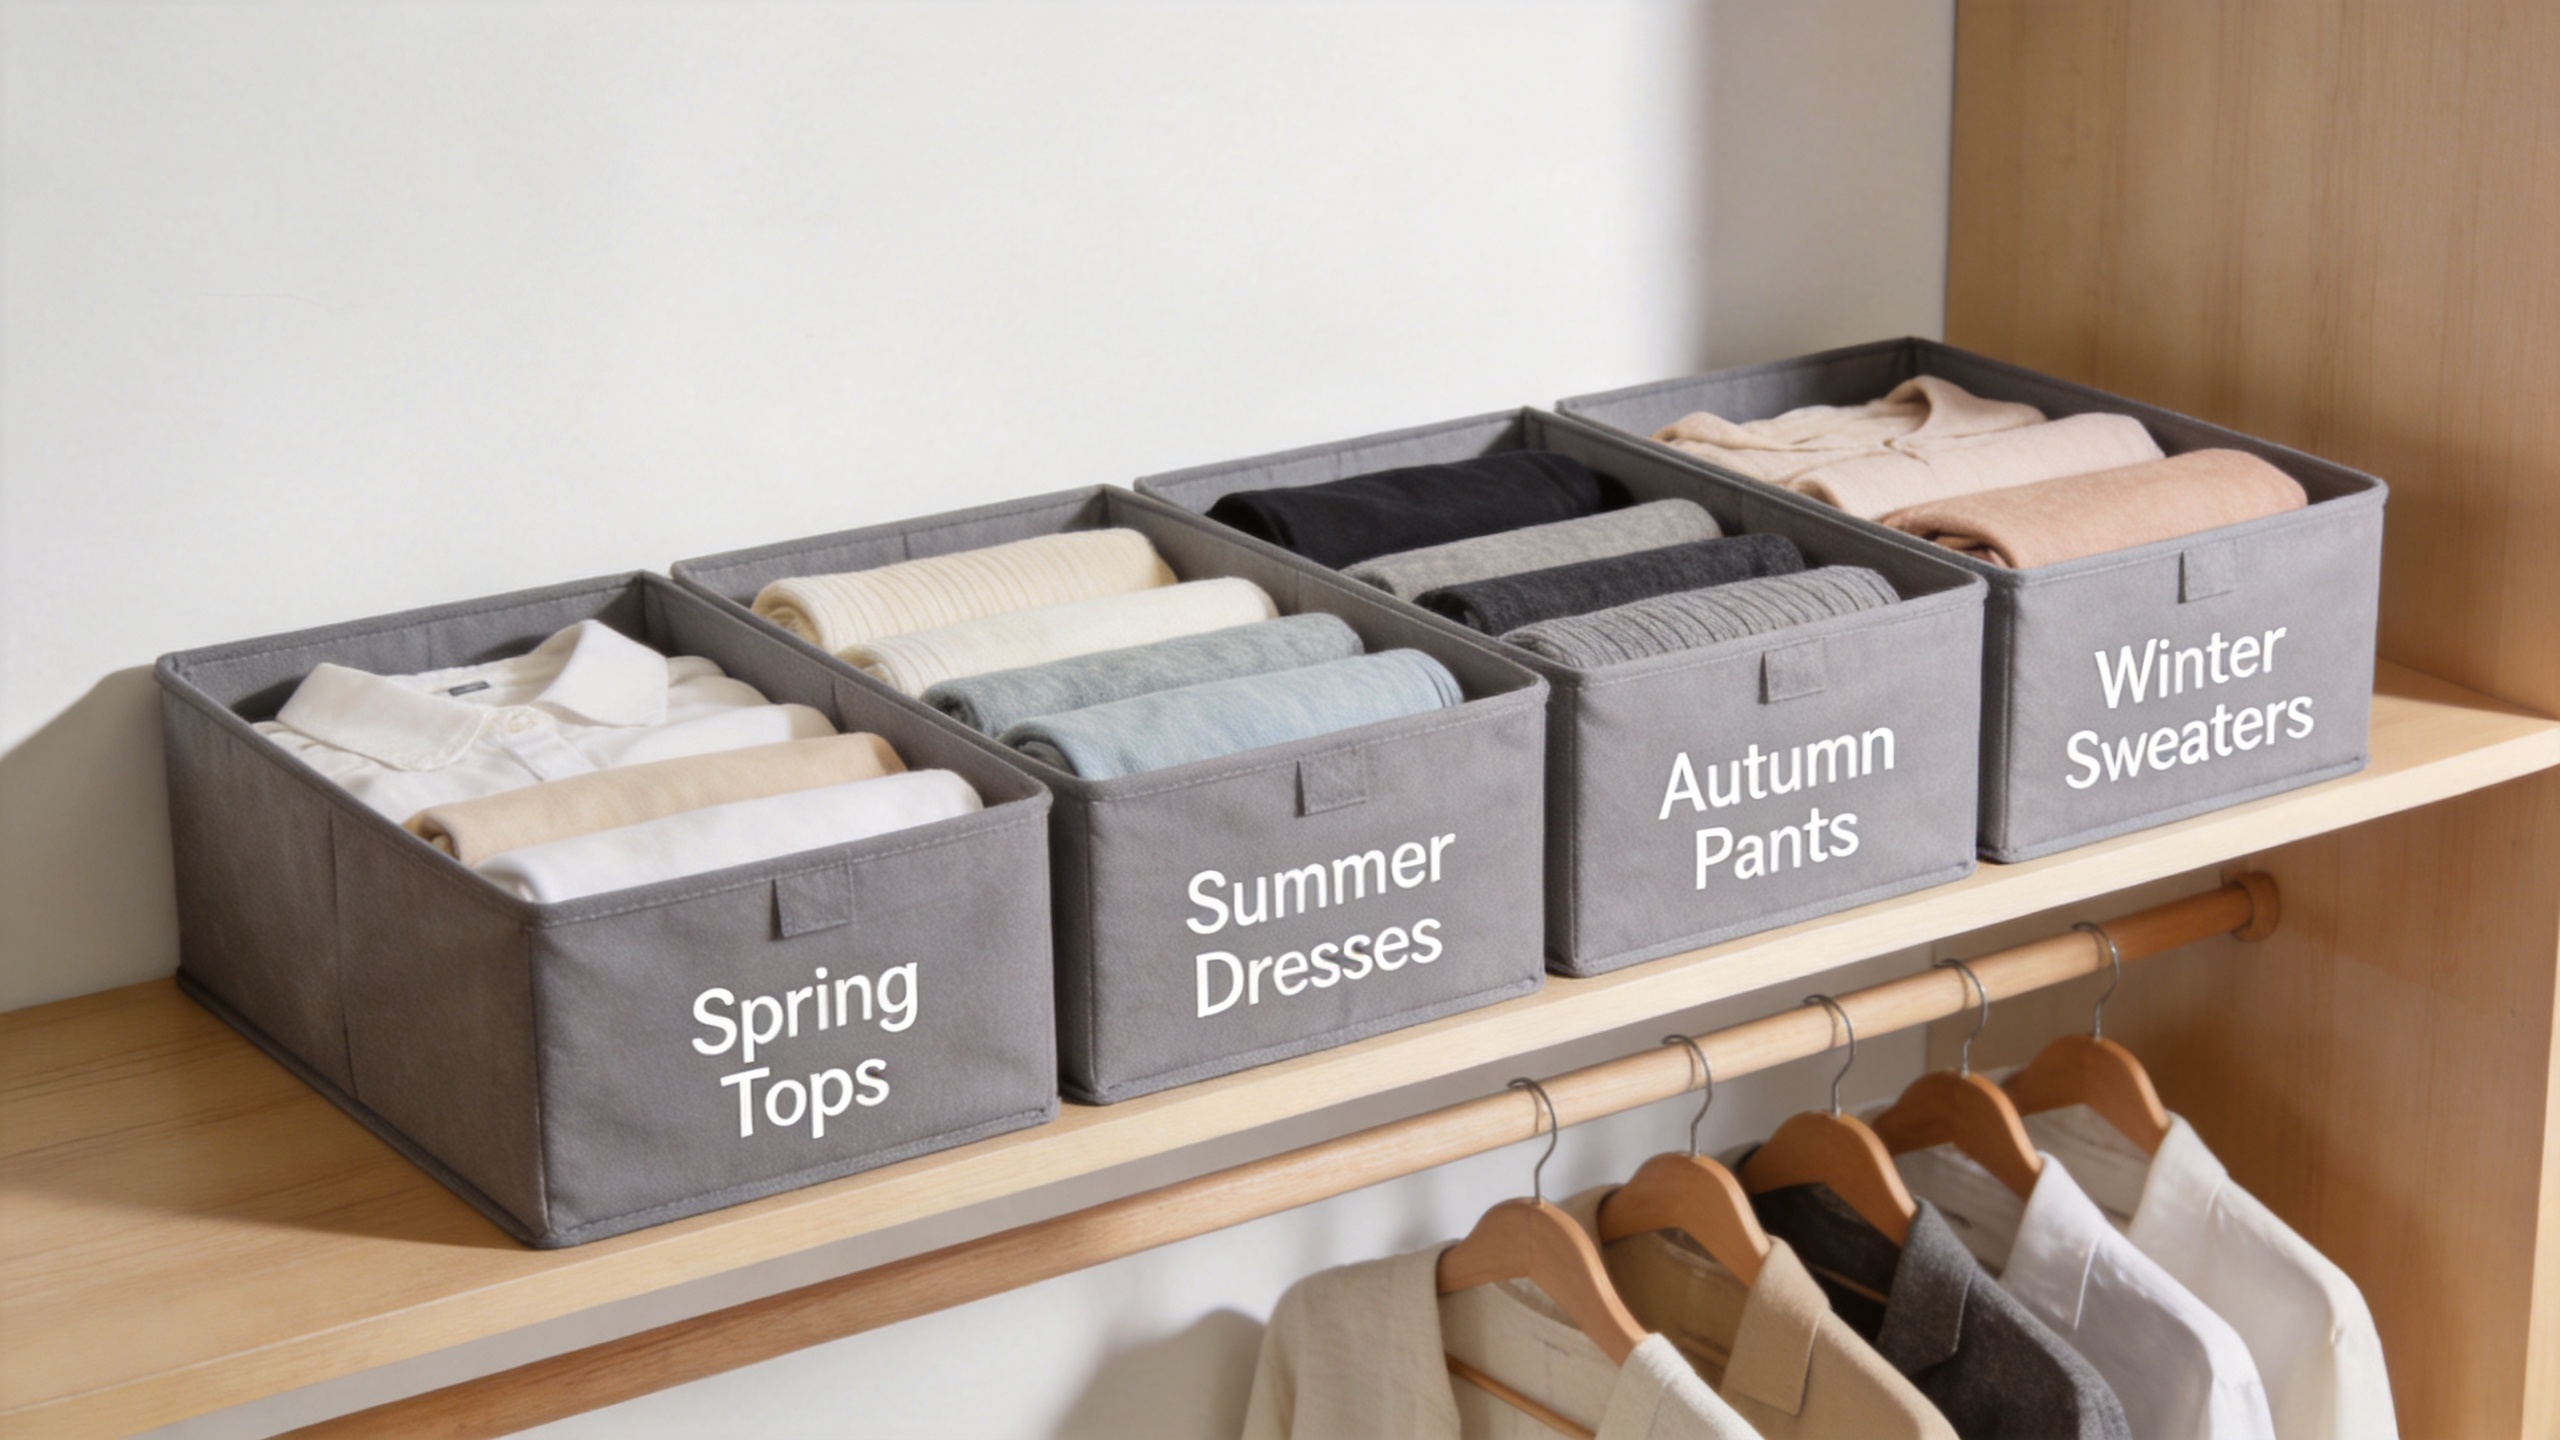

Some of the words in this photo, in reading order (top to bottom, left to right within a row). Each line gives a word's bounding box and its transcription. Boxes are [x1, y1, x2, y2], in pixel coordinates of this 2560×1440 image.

[2092, 625, 2289, 711] Winter
[1656, 725, 1897, 822] Autumn
[2063, 694, 2316, 791] Sweaters
[1184, 831, 1458, 936] Summer
[1694, 806, 1861, 892] Pants
[690, 961, 919, 1065] Spring
[1194, 916, 1444, 1020] Dresses
[719, 1057, 891, 1140] Tops
